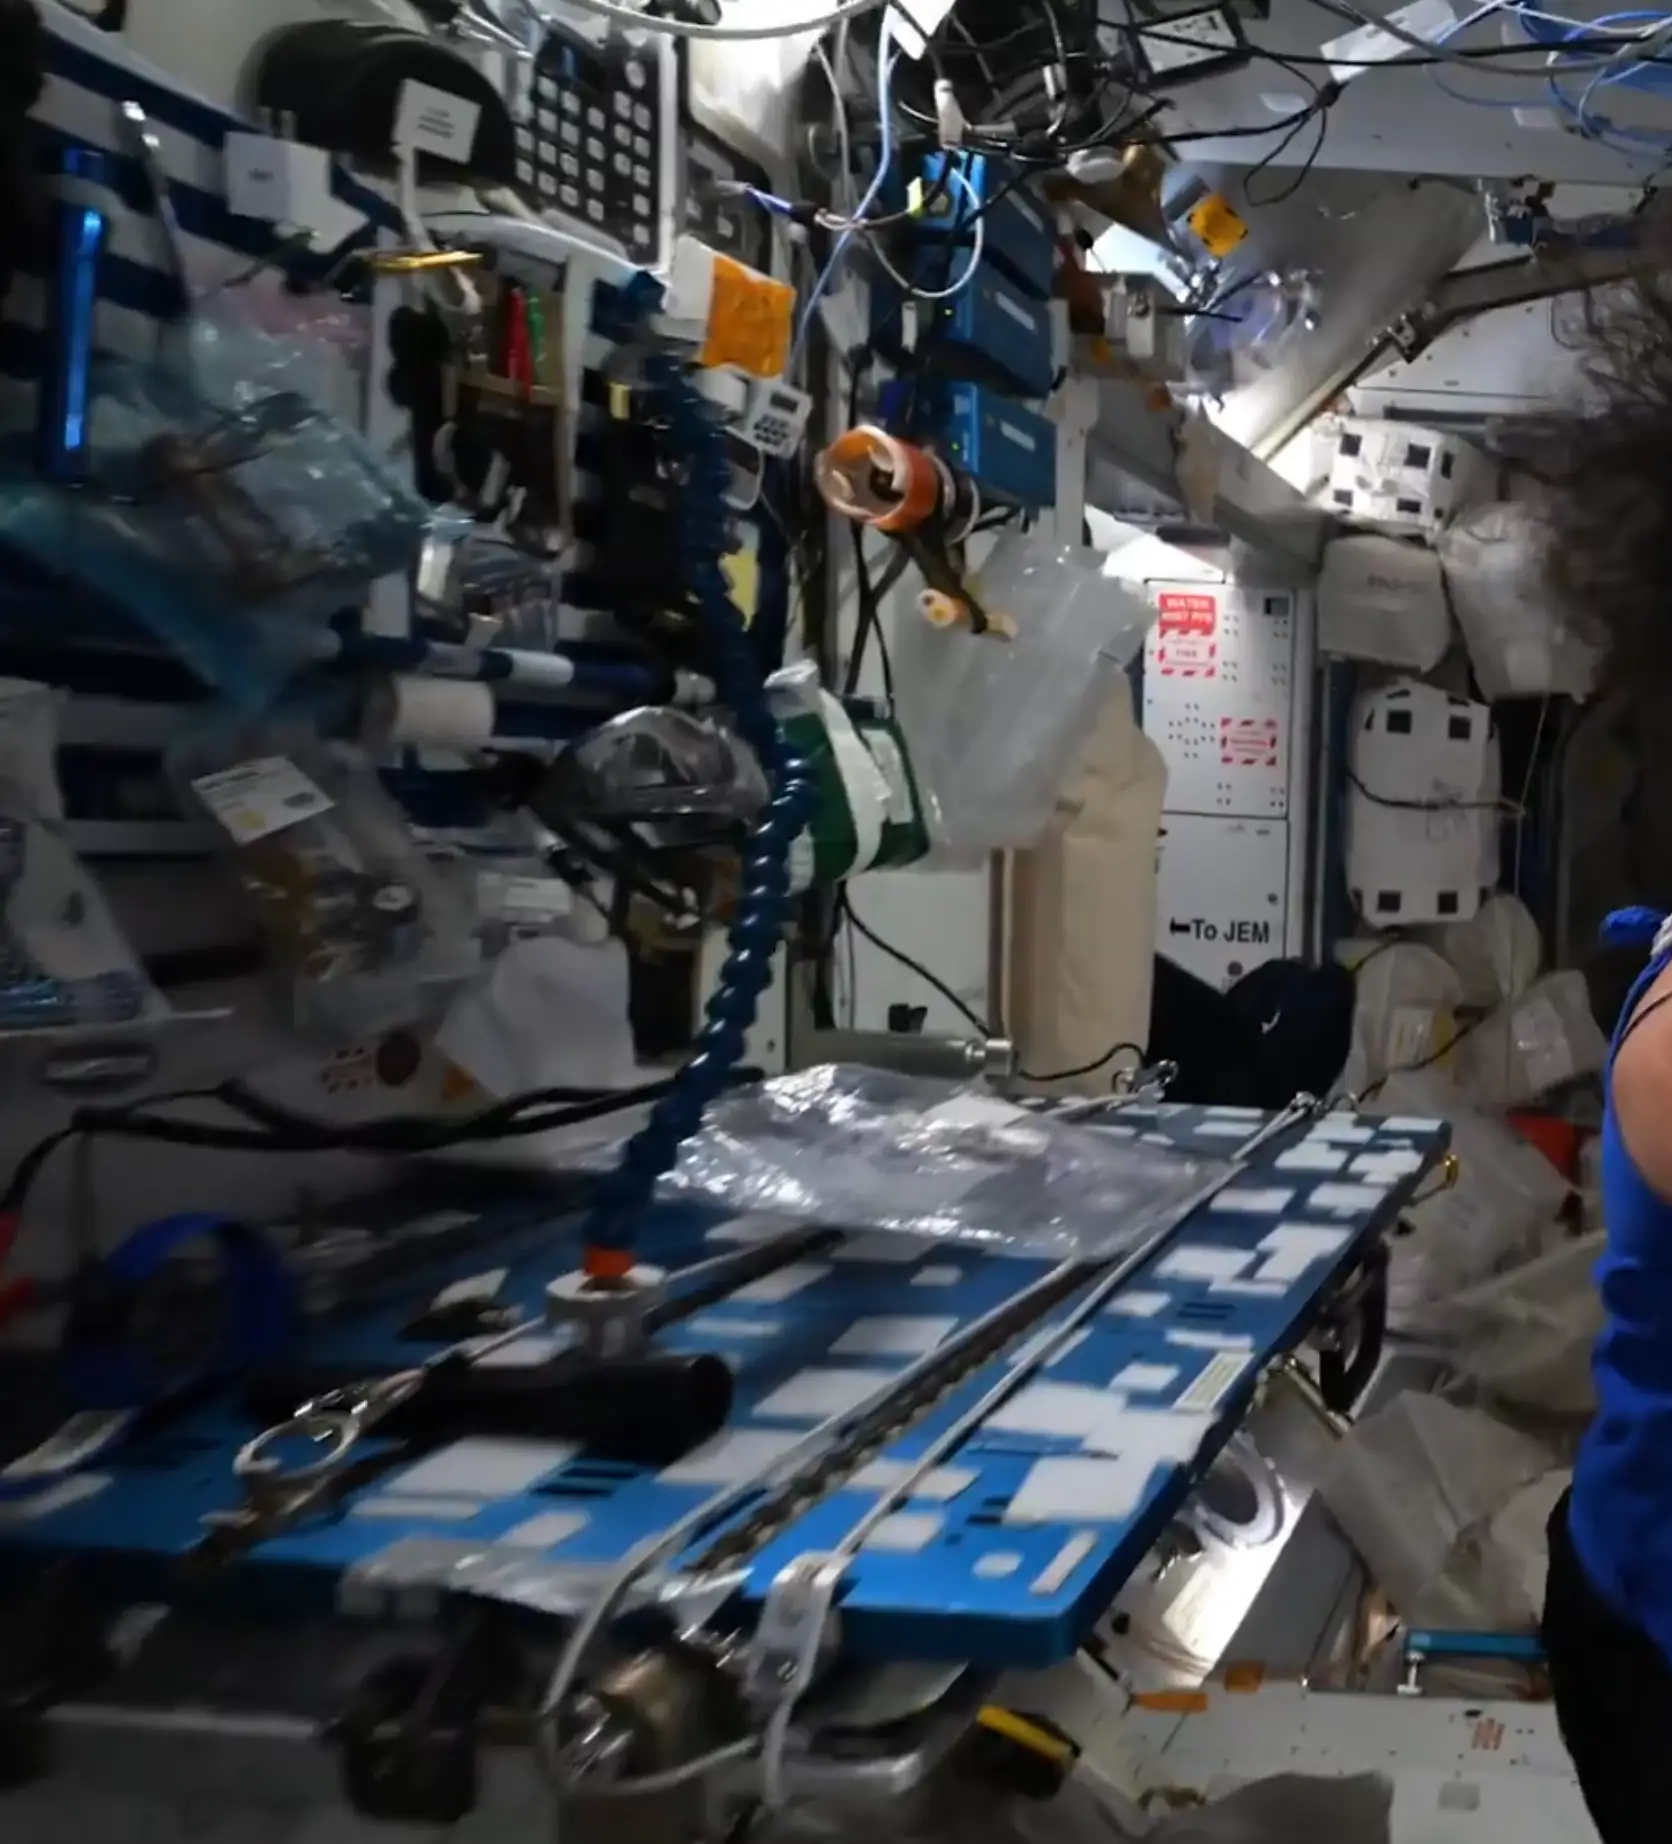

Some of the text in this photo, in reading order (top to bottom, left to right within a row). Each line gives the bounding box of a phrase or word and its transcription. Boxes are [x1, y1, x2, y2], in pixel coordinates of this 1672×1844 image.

[1166, 597, 1210, 610] WATER
[1192, 918, 1270, 944] To JEM
